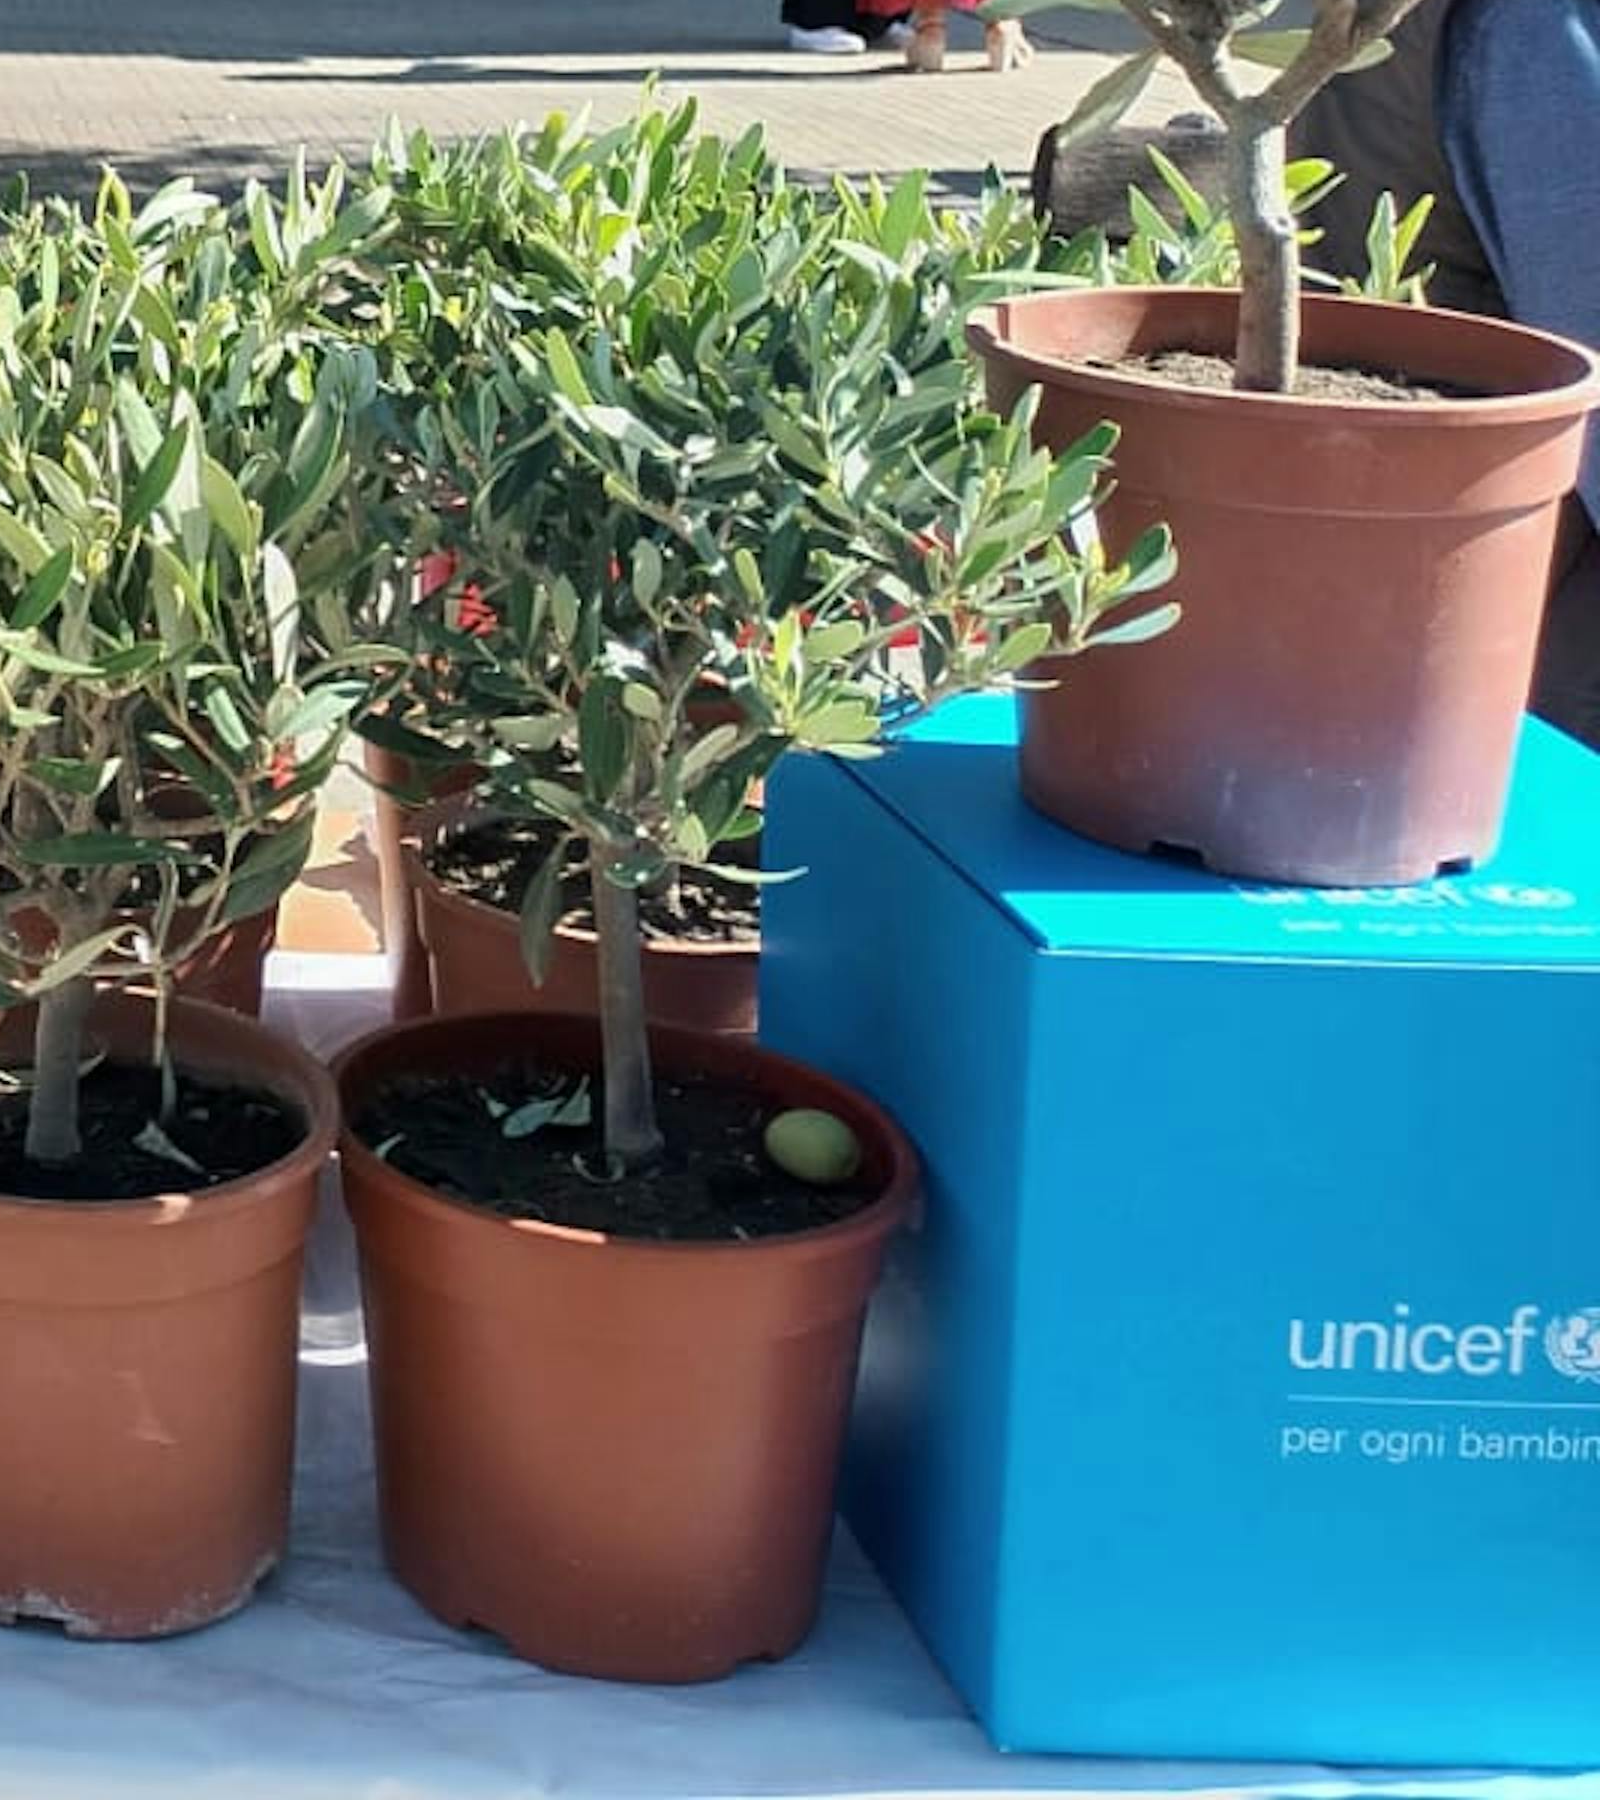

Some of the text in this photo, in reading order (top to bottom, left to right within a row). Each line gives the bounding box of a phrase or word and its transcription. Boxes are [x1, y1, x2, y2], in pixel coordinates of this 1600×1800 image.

[1289, 1303, 1541, 1375] unicef
[1281, 1426, 1348, 1457] per
[1360, 1424, 1445, 1463] ogni
